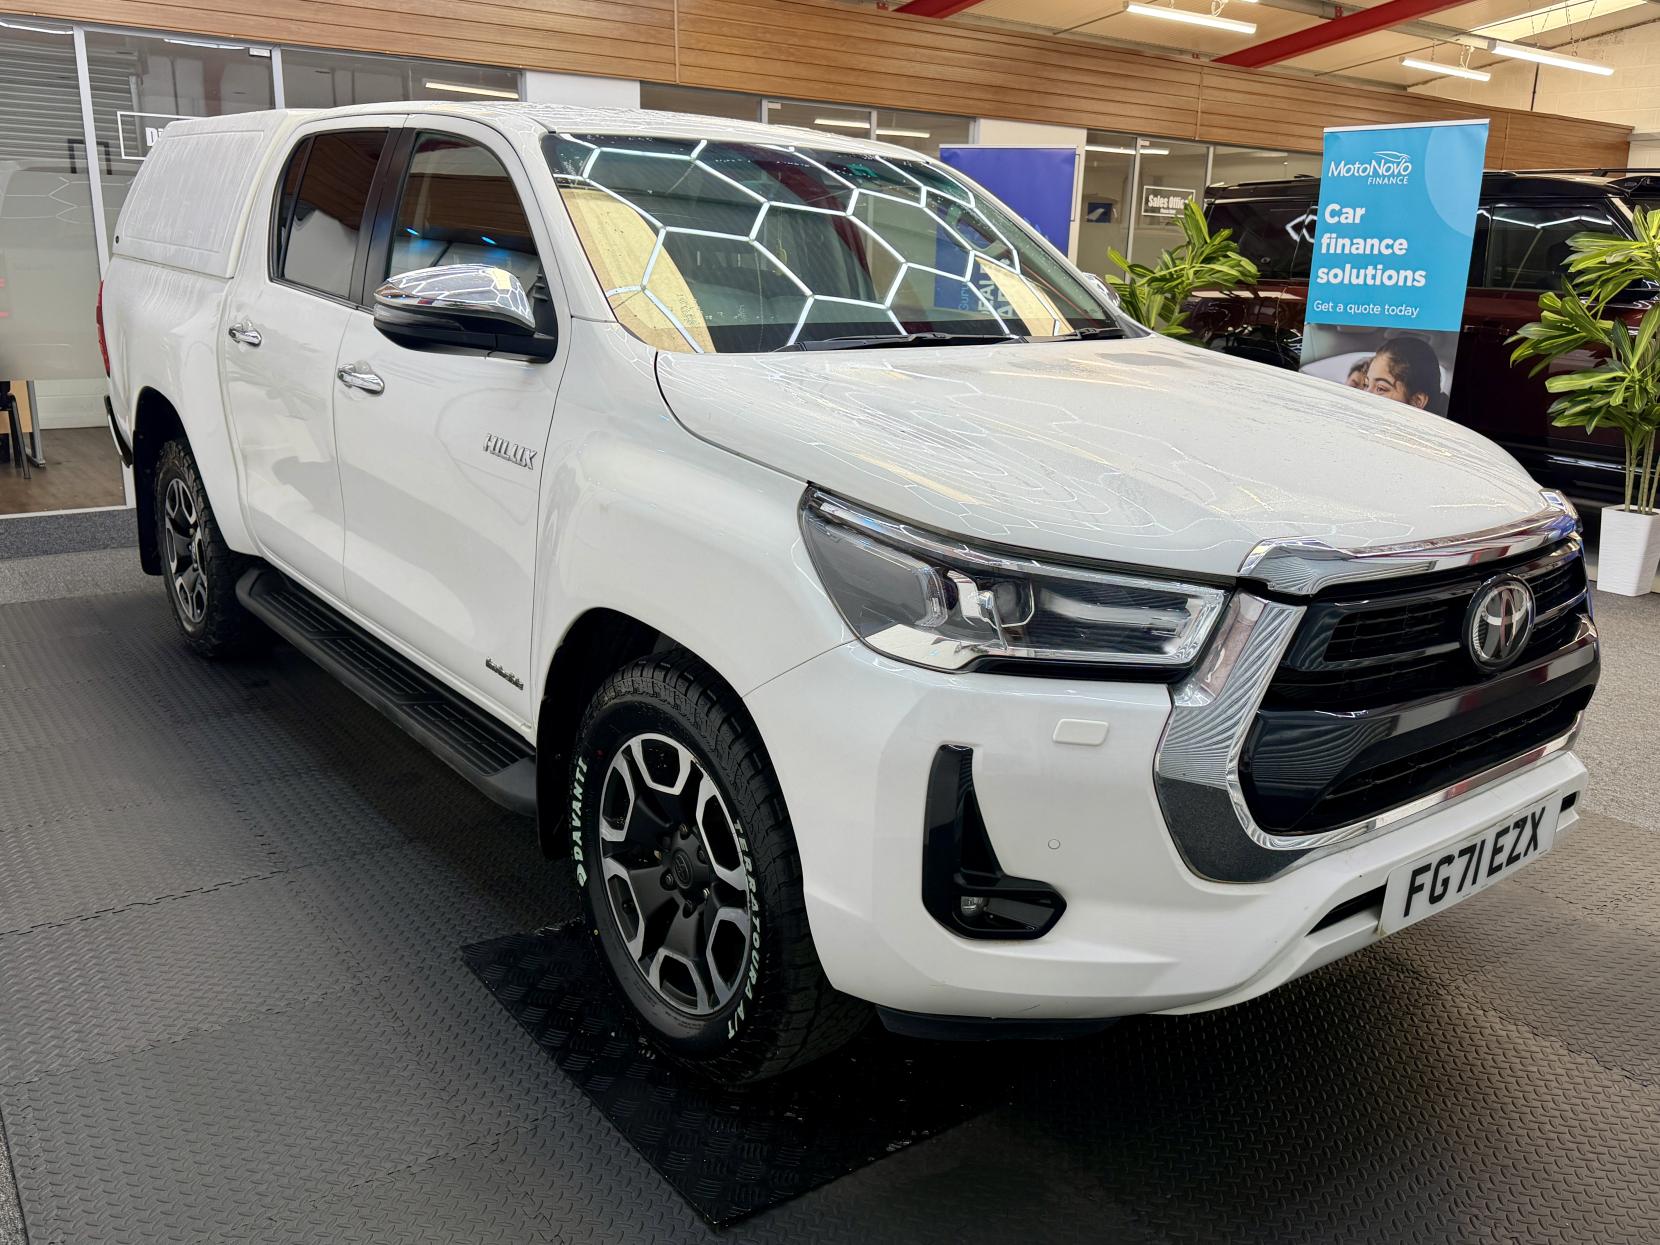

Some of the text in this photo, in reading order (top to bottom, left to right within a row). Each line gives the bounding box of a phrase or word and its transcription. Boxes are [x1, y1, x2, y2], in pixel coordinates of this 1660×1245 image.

[1328, 160, 1412, 177] MotoNovo
[1367, 176, 1409, 185] FINANCE
[1148, 194, 1168, 208] Sales
[1324, 203, 1366, 224] Car
[1321, 233, 1408, 255] finance
[1316, 264, 1427, 287] solutions
[1313, 300, 1420, 318] Get a quote today
[484, 433, 538, 471] HILUX
[571, 756, 588, 862] DAVANTI
[1403, 806, 1546, 918] FG71 EZX
